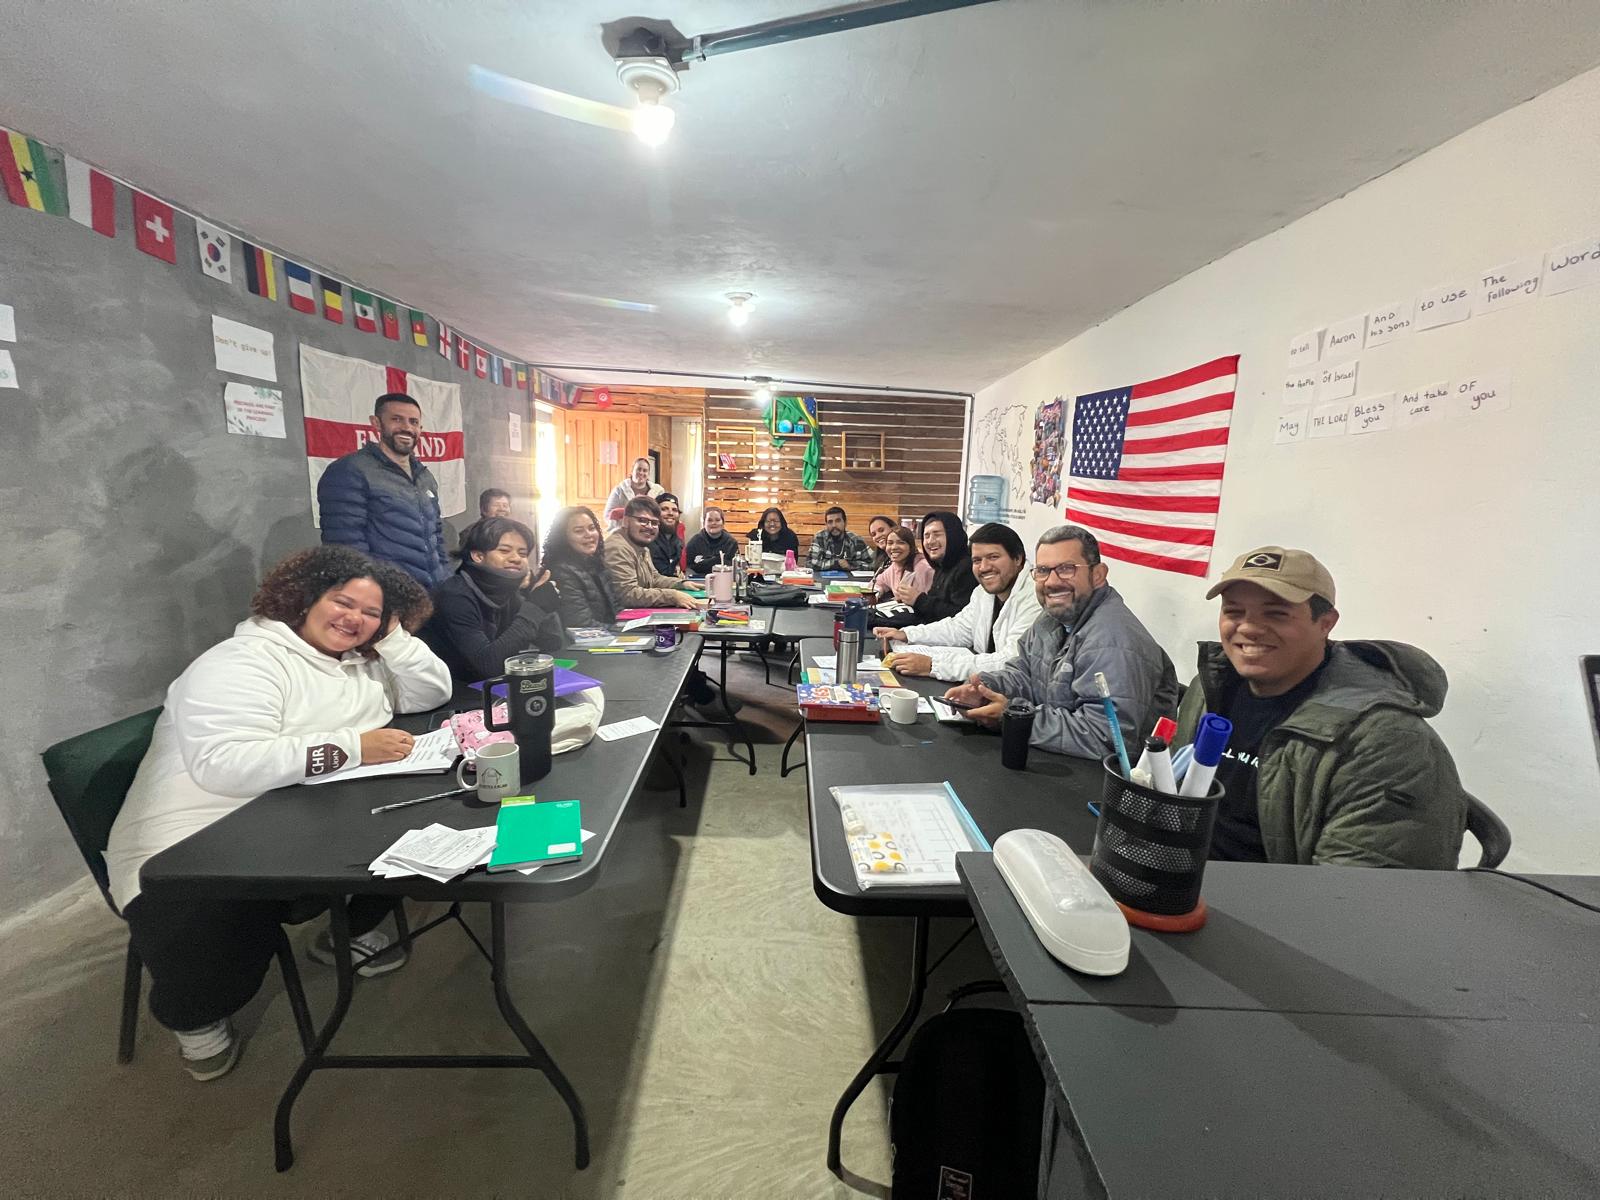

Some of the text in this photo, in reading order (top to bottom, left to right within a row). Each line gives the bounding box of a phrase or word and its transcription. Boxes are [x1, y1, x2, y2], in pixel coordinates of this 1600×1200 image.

[1482, 275, 1507, 288] The
[1420, 300, 1434, 312] to
[1329, 332, 1357, 348] Aaron
[1424, 388, 1448, 399] take
[1471, 390, 1496, 410] you
[1410, 405, 1430, 415] care
[1279, 421, 1299, 437] May
[1361, 415, 1380, 429] you
[311, 747, 325, 775] CHR
